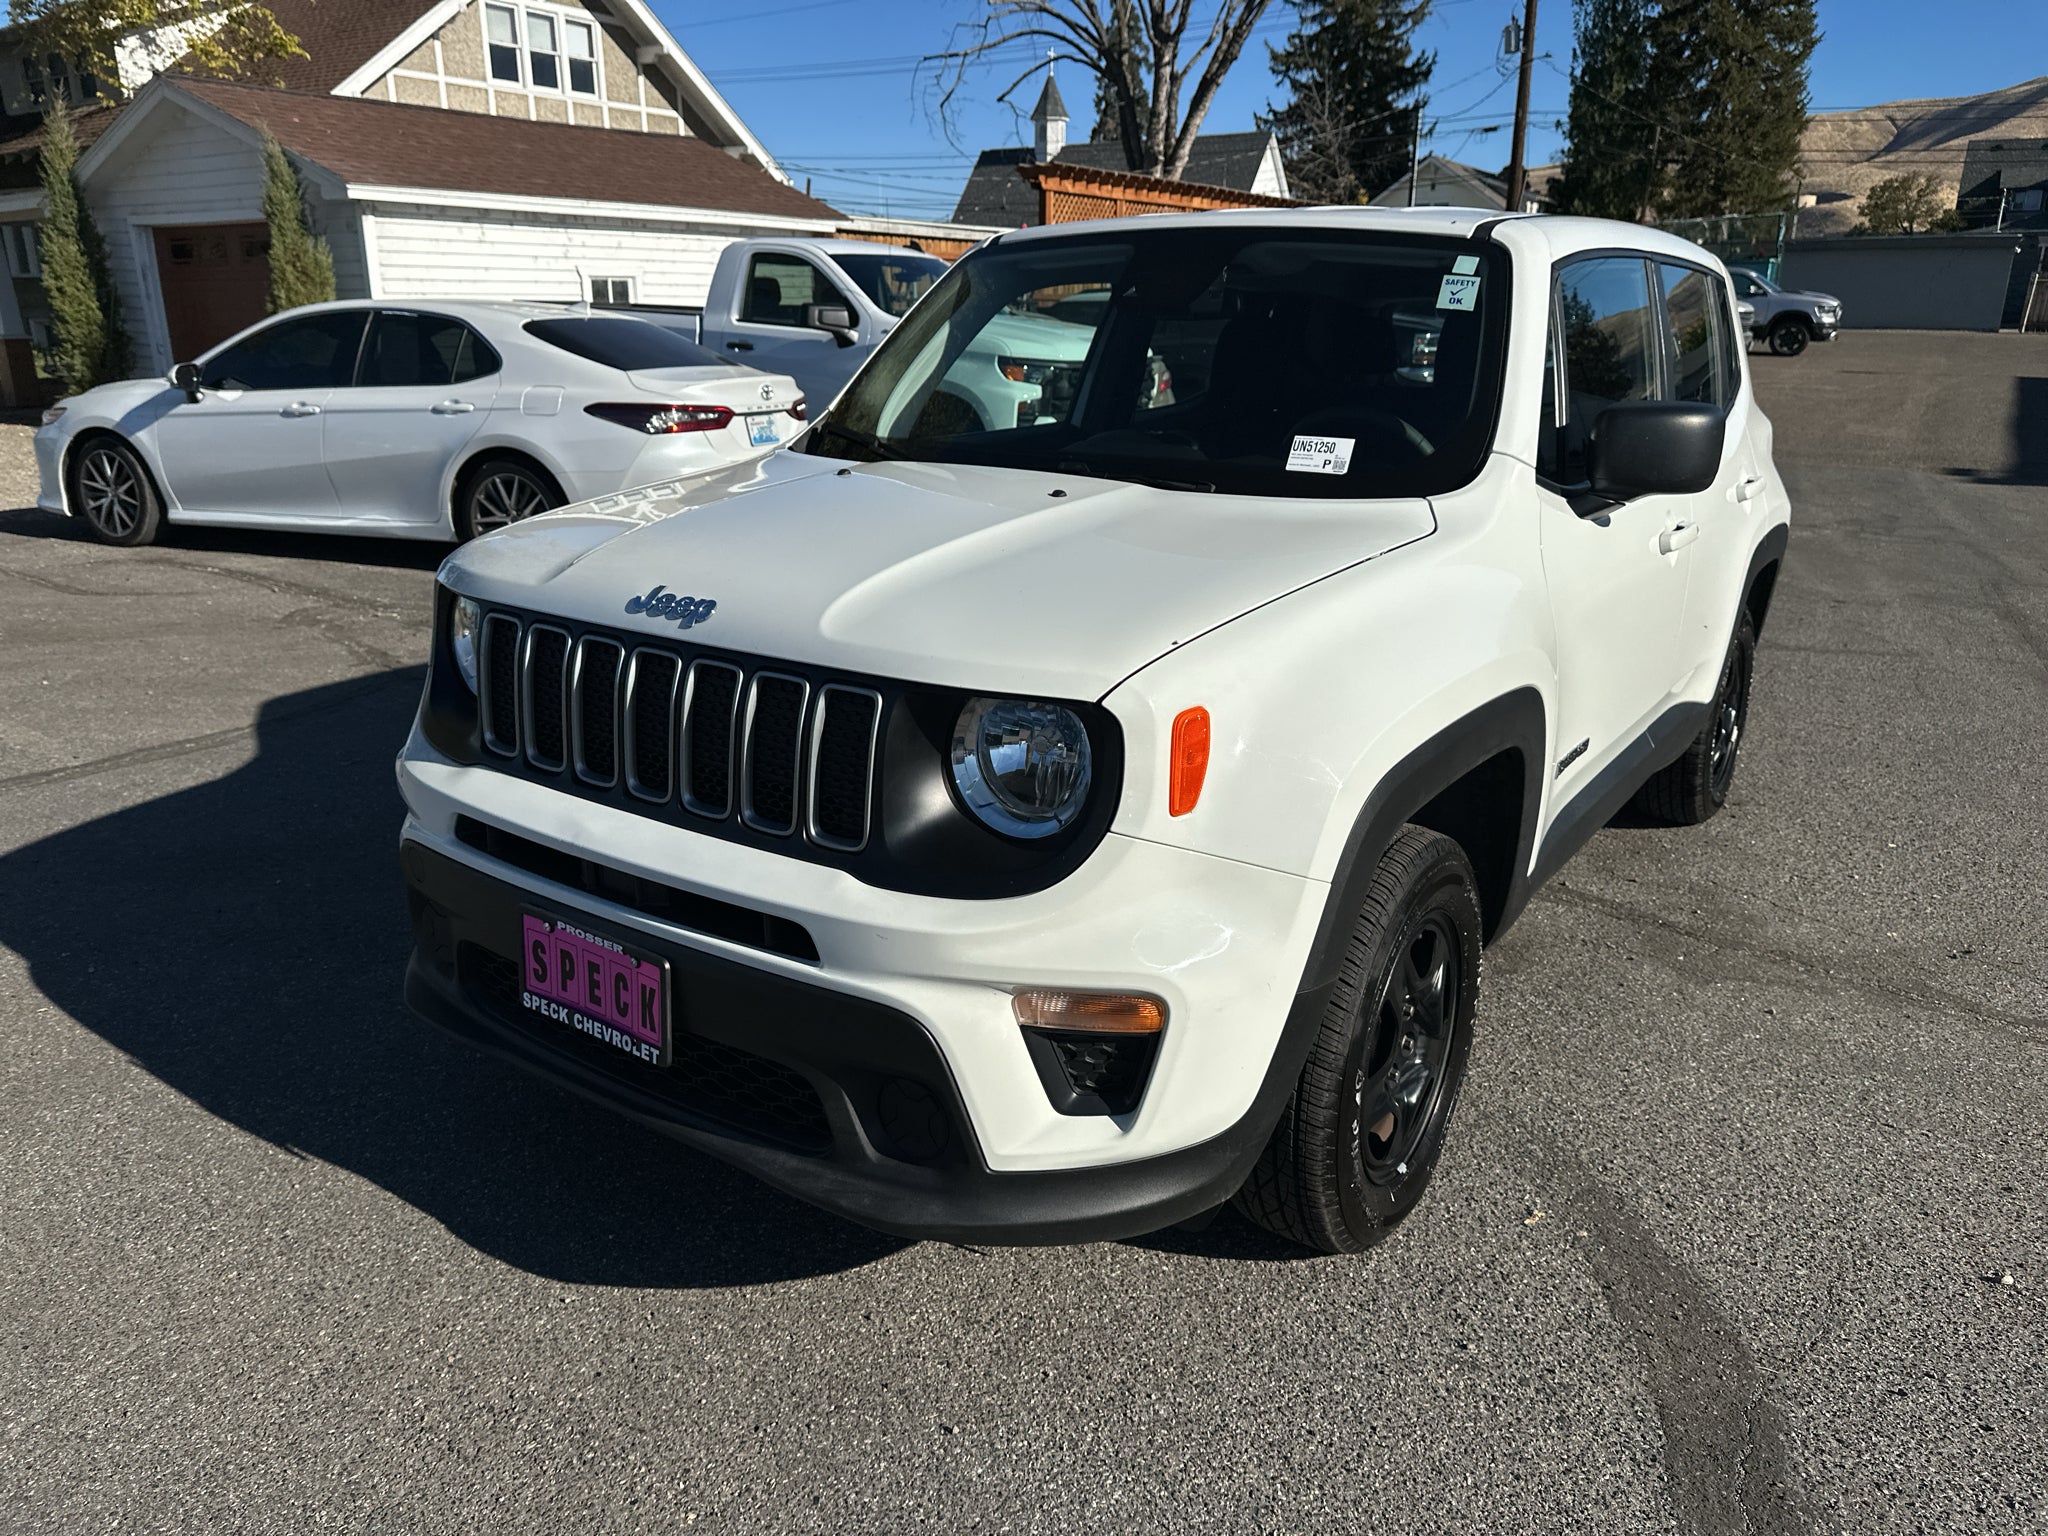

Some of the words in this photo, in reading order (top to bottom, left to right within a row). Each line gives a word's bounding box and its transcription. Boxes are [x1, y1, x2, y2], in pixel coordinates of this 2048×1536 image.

[1444, 278, 1476, 287] SAFETY
[1448, 297, 1463, 305] OK
[1292, 439, 1336, 453] UN51250
[1322, 459, 1332, 469] P
[624, 584, 717, 630] Jeep
[556, 920, 624, 955] PROSSER
[532, 939, 657, 1034] SPECK
[522, 991, 570, 1025] SPECK
[573, 1012, 660, 1065] CHEVROLET
